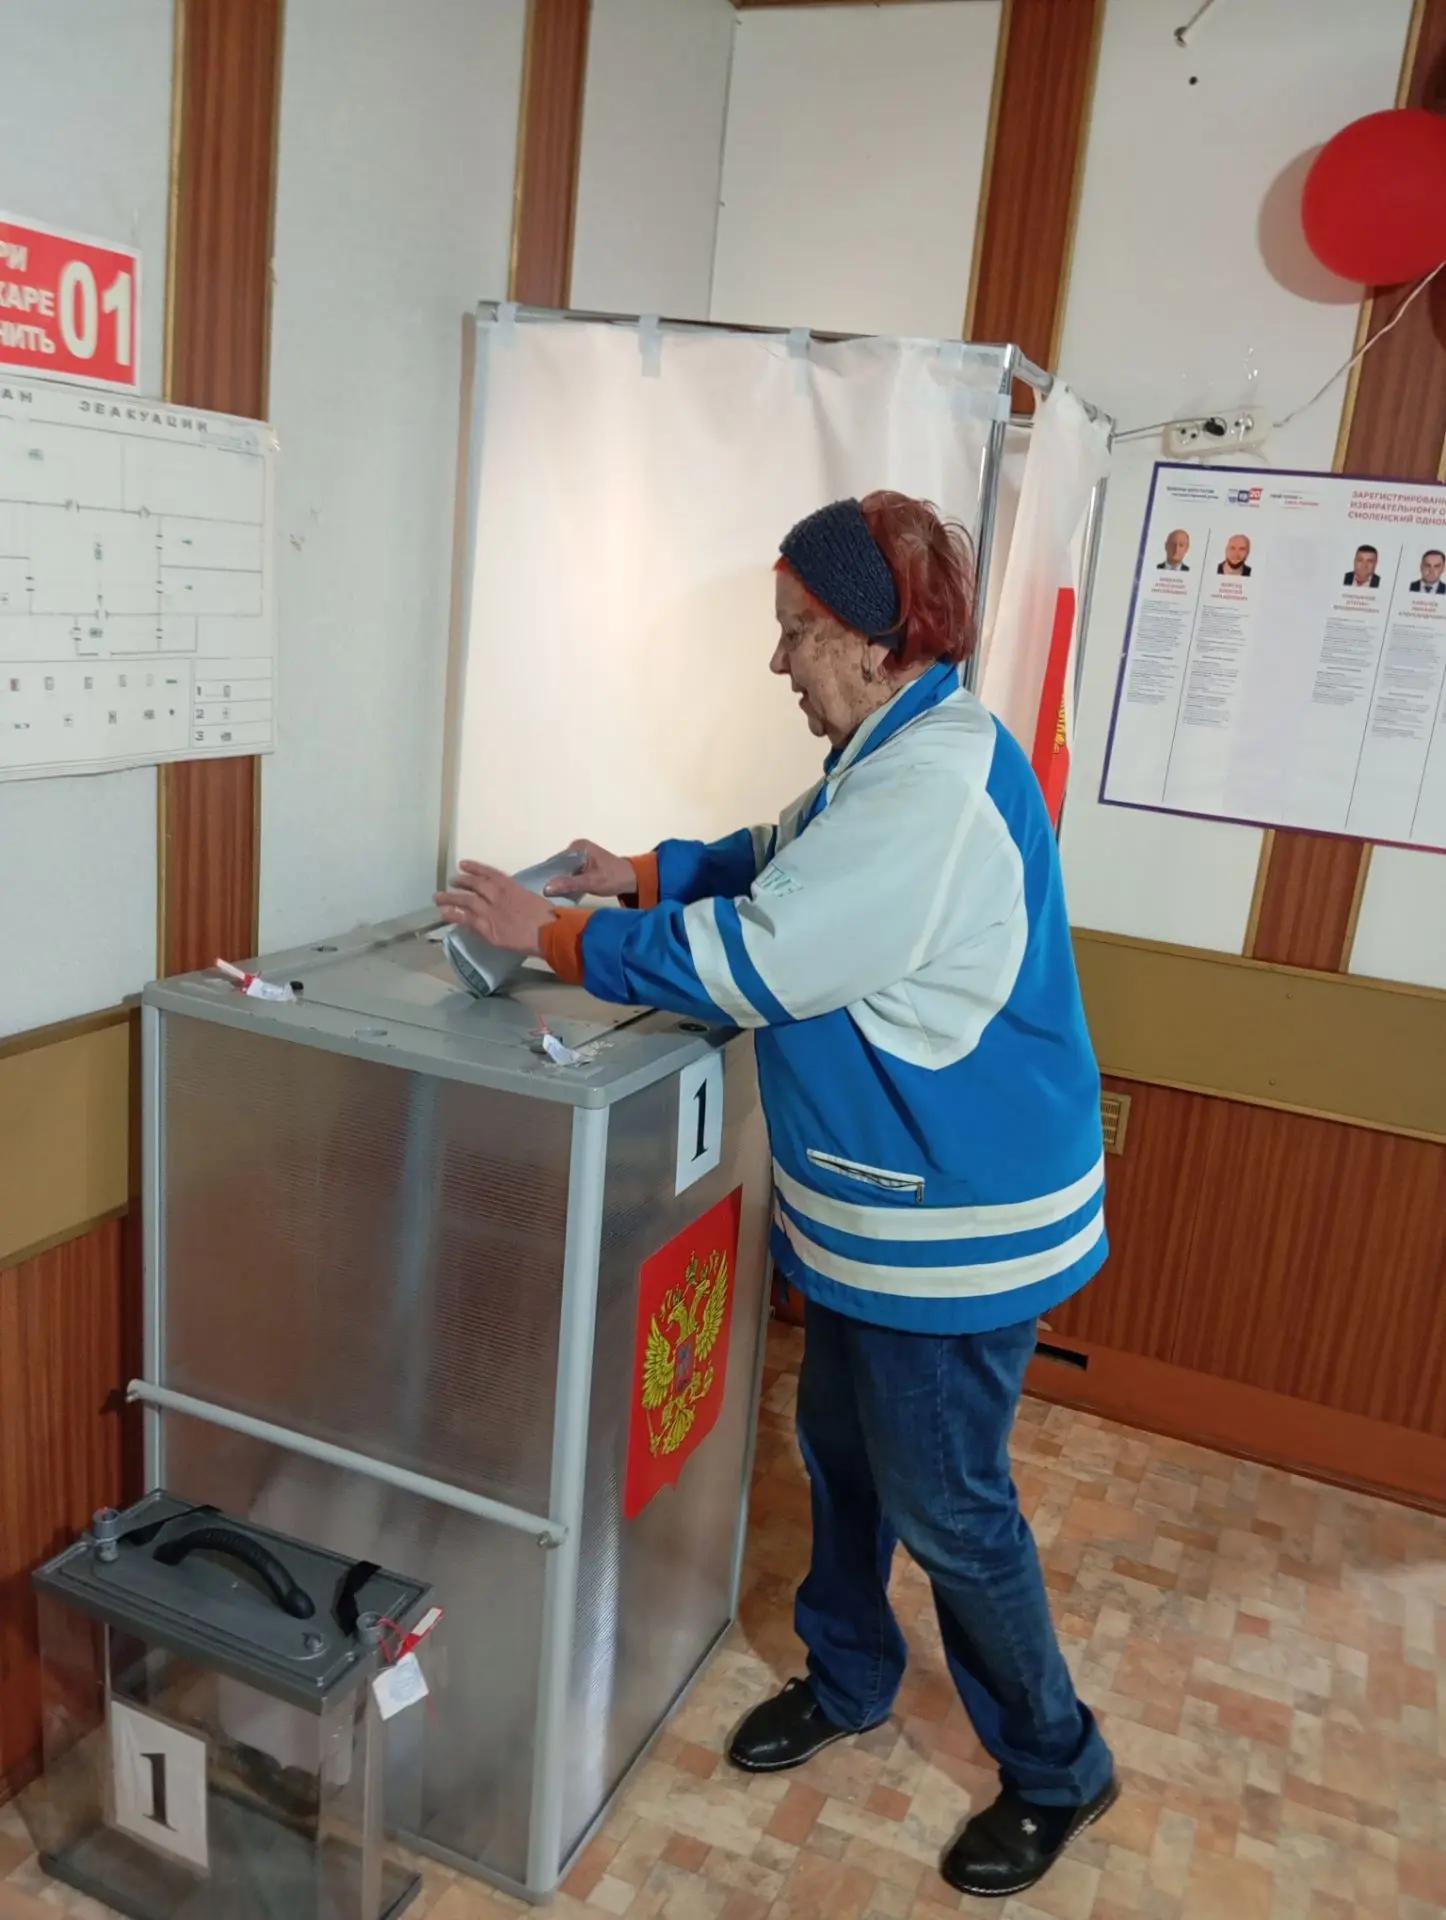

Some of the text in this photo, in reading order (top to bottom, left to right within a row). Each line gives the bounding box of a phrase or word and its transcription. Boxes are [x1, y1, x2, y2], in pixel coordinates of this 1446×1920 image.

[58, 260, 132, 367] 01
[691, 1078, 709, 1162] 1
[140, 1753, 178, 1832] 1
